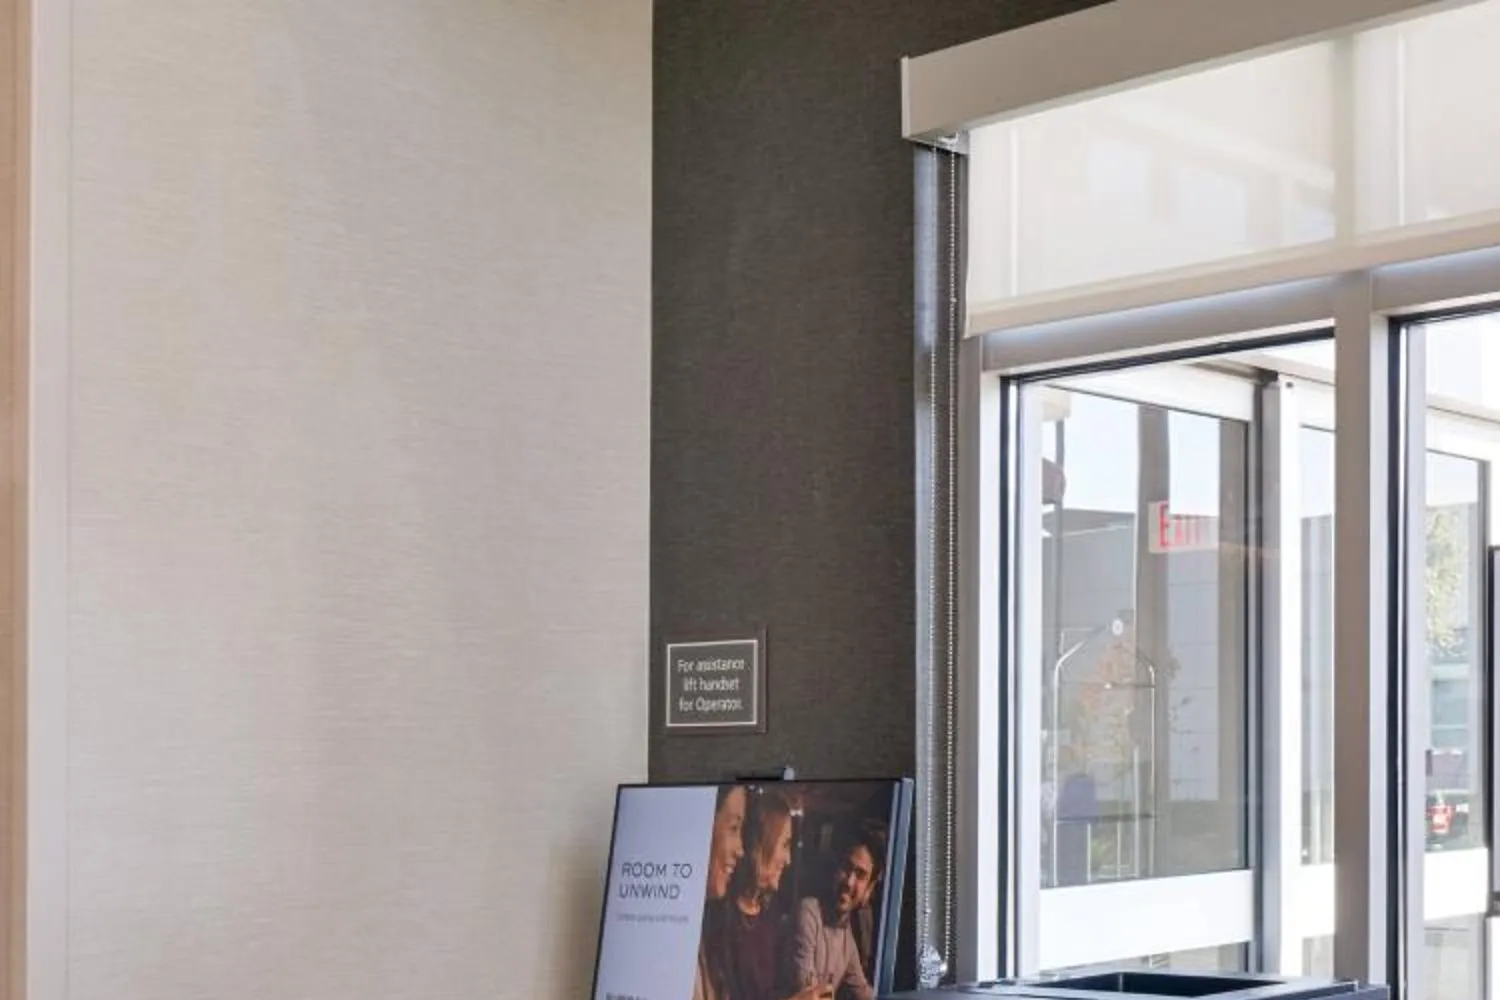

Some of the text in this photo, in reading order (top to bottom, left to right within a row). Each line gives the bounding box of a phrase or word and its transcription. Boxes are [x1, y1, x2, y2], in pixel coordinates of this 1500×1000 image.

[677, 659, 694, 672] For
[621, 862, 693, 878] ROOM TO
[619, 883, 681, 900] UNWIND
